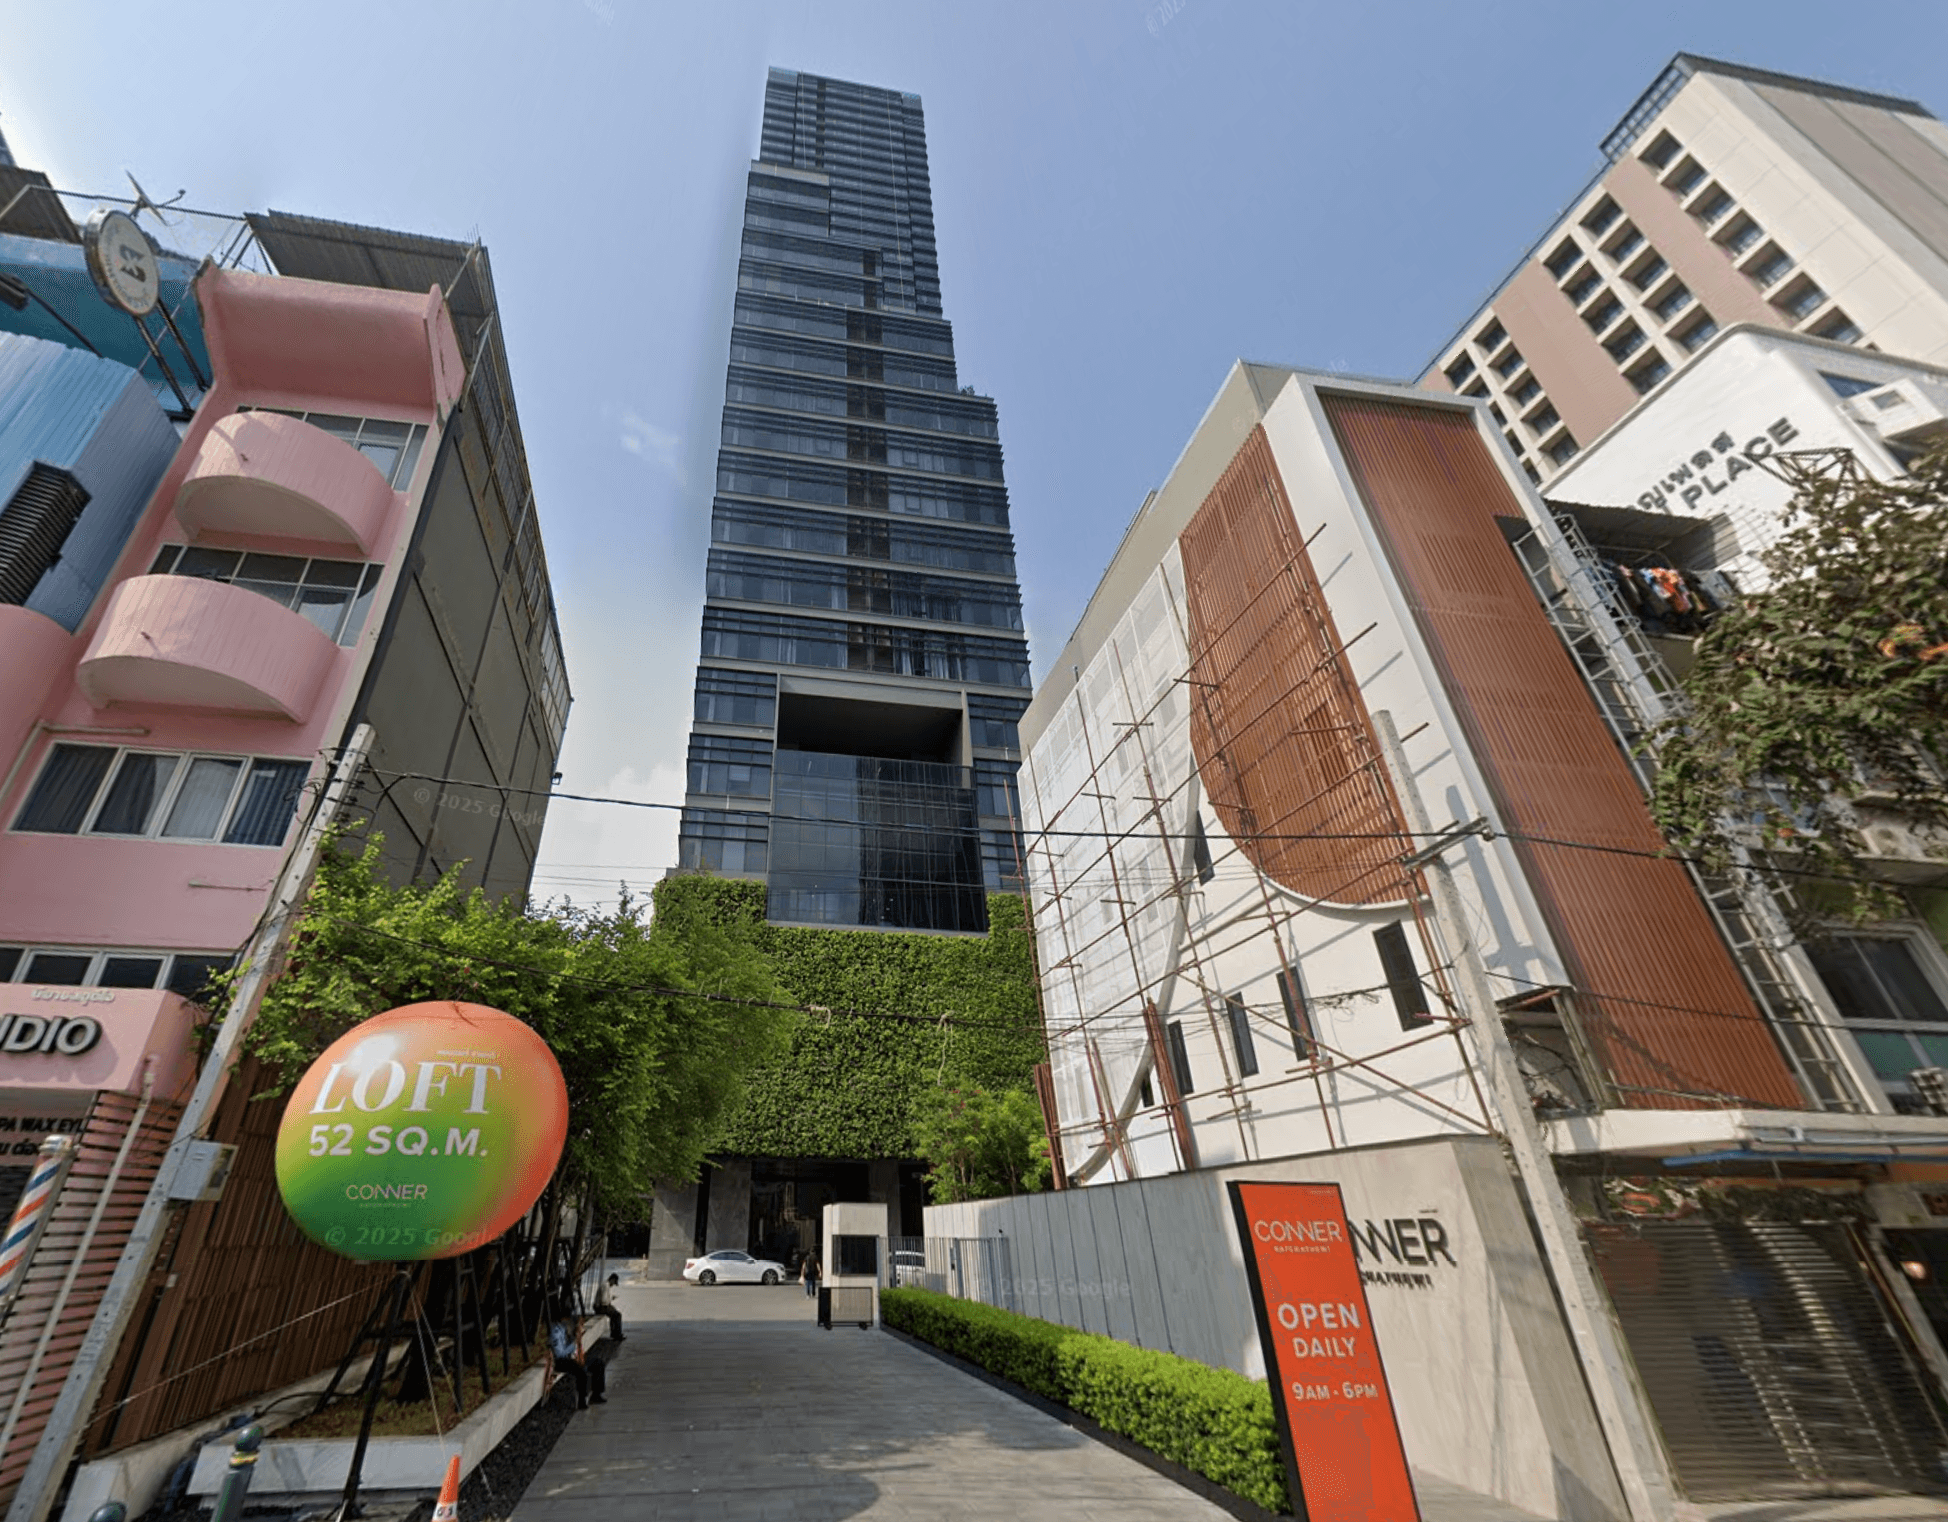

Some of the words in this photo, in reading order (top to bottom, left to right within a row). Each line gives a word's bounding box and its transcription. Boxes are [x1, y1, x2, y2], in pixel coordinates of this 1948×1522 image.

[1679, 416, 1800, 510] PLACE
[309, 1060, 502, 1115] LOFT
[309, 1123, 354, 1157] 52
[364, 1124, 488, 1157] SQ.M.
[346, 1183, 428, 1200] CONNER
[1254, 1219, 1343, 1243] CONNER
[1277, 1302, 1360, 1330] OPEN
[1292, 1336, 1356, 1358] DAILY
